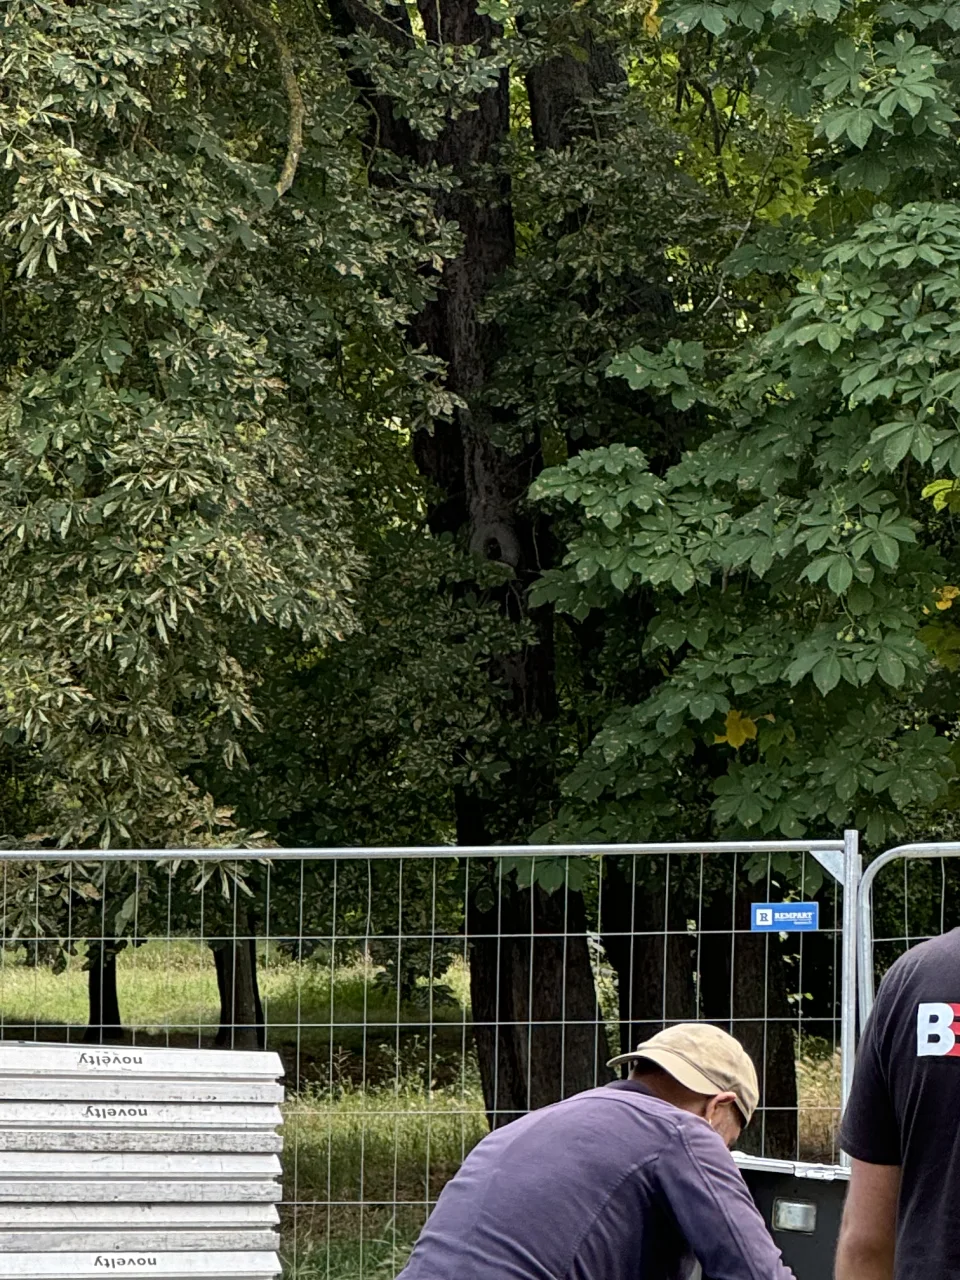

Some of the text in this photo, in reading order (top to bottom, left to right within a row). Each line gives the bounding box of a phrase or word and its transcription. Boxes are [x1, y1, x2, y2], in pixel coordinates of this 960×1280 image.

[759, 912, 769, 922] R
[78, 1053, 143, 1066] novelty
[84, 1105, 148, 1119] novelty
[94, 1255, 157, 1269] novelty
